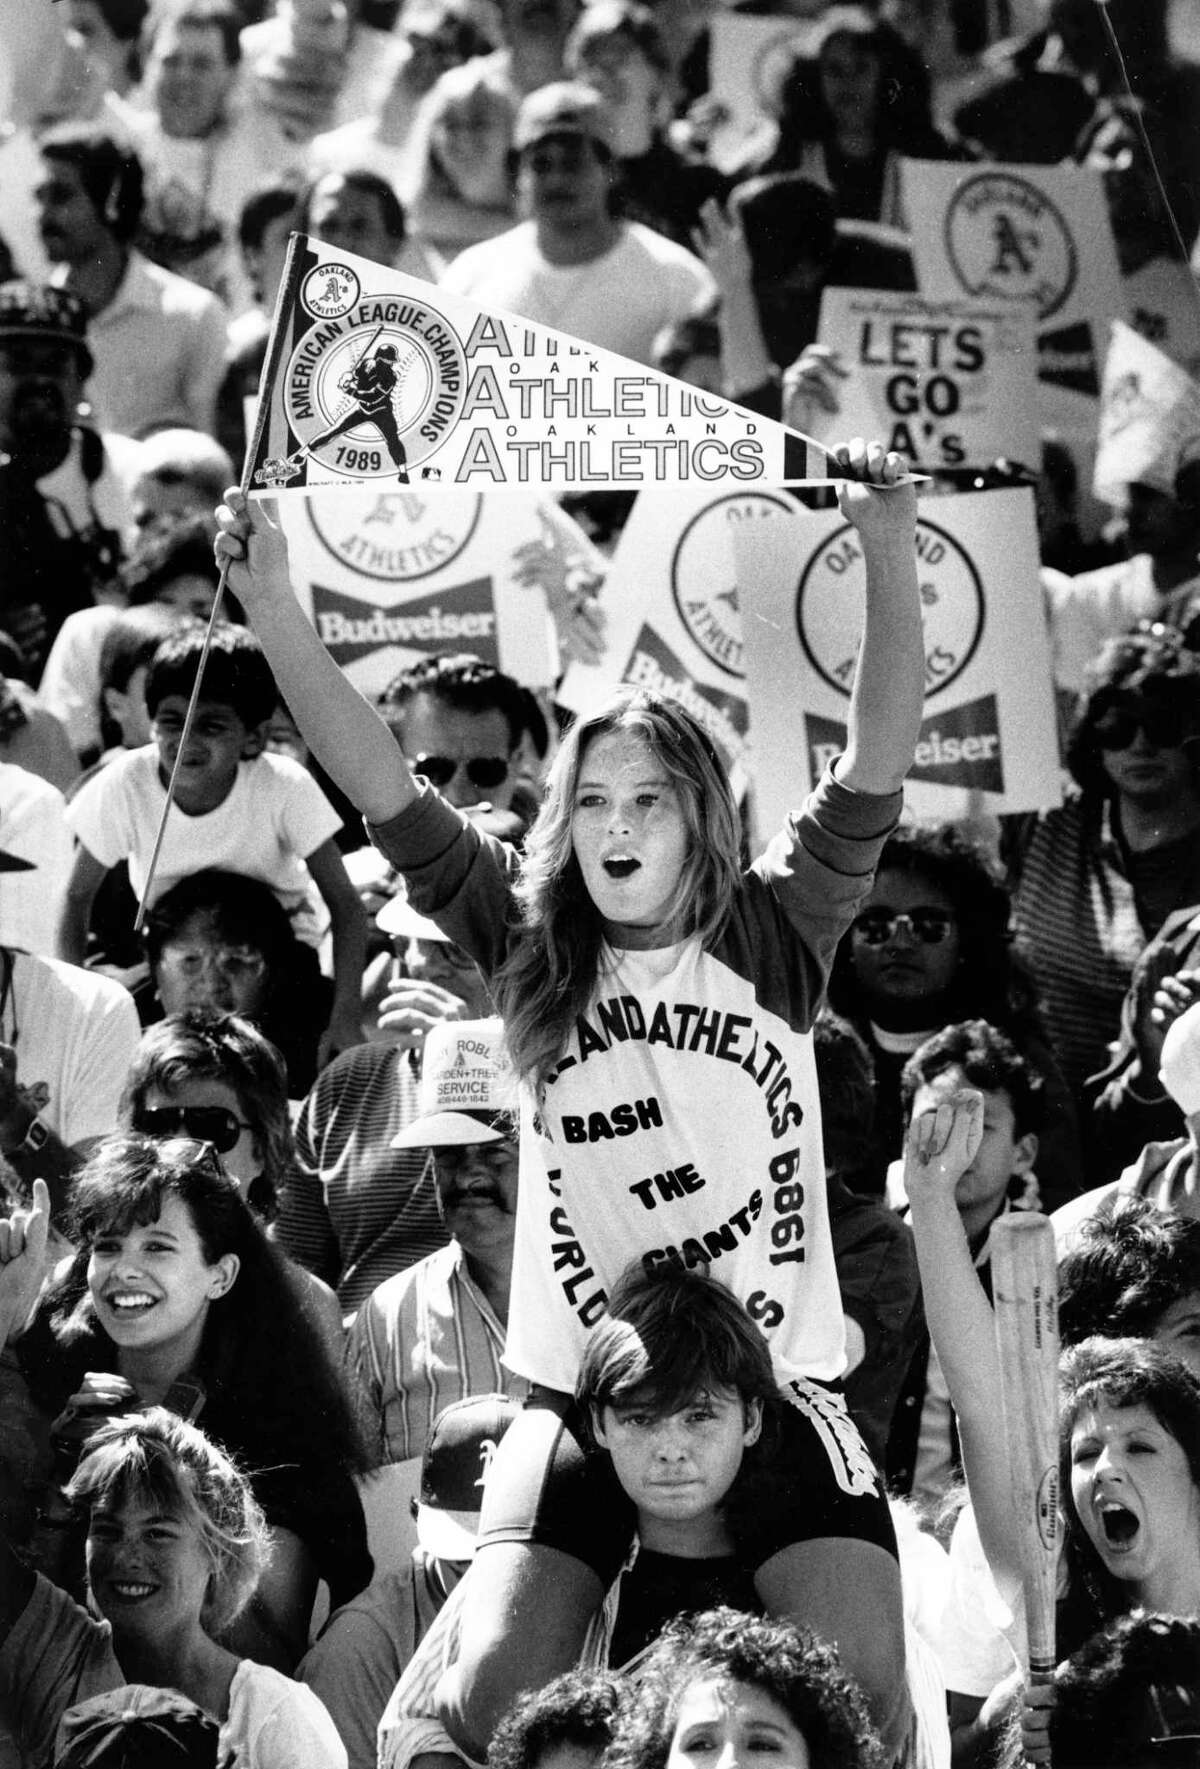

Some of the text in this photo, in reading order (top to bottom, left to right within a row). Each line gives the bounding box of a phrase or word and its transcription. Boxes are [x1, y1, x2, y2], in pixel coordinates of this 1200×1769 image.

[318, 264, 355, 284] OAKLAND
[308, 299, 348, 316] ATHLETICS
[859, 319, 986, 374] LETS
[291, 320, 344, 421] AMERICAN
[348, 302, 427, 331] LEAGUE
[421, 322, 461, 443] CHAMPIONS
[885, 374, 961, 418] GO
[506, 422, 758, 437] OAKLAND
[335, 447, 382, 472] 1989
[454, 426, 766, 483] ATHLETICS
[339, 529, 455, 573] ATHLETICS
[317, 605, 495, 646] Budweiser
[685, 600, 744, 666] ATHLET
[437, 1080, 490, 1096] SERVICE
[560, 1097, 664, 1144] BASH
[628, 1162, 706, 1211] THE
